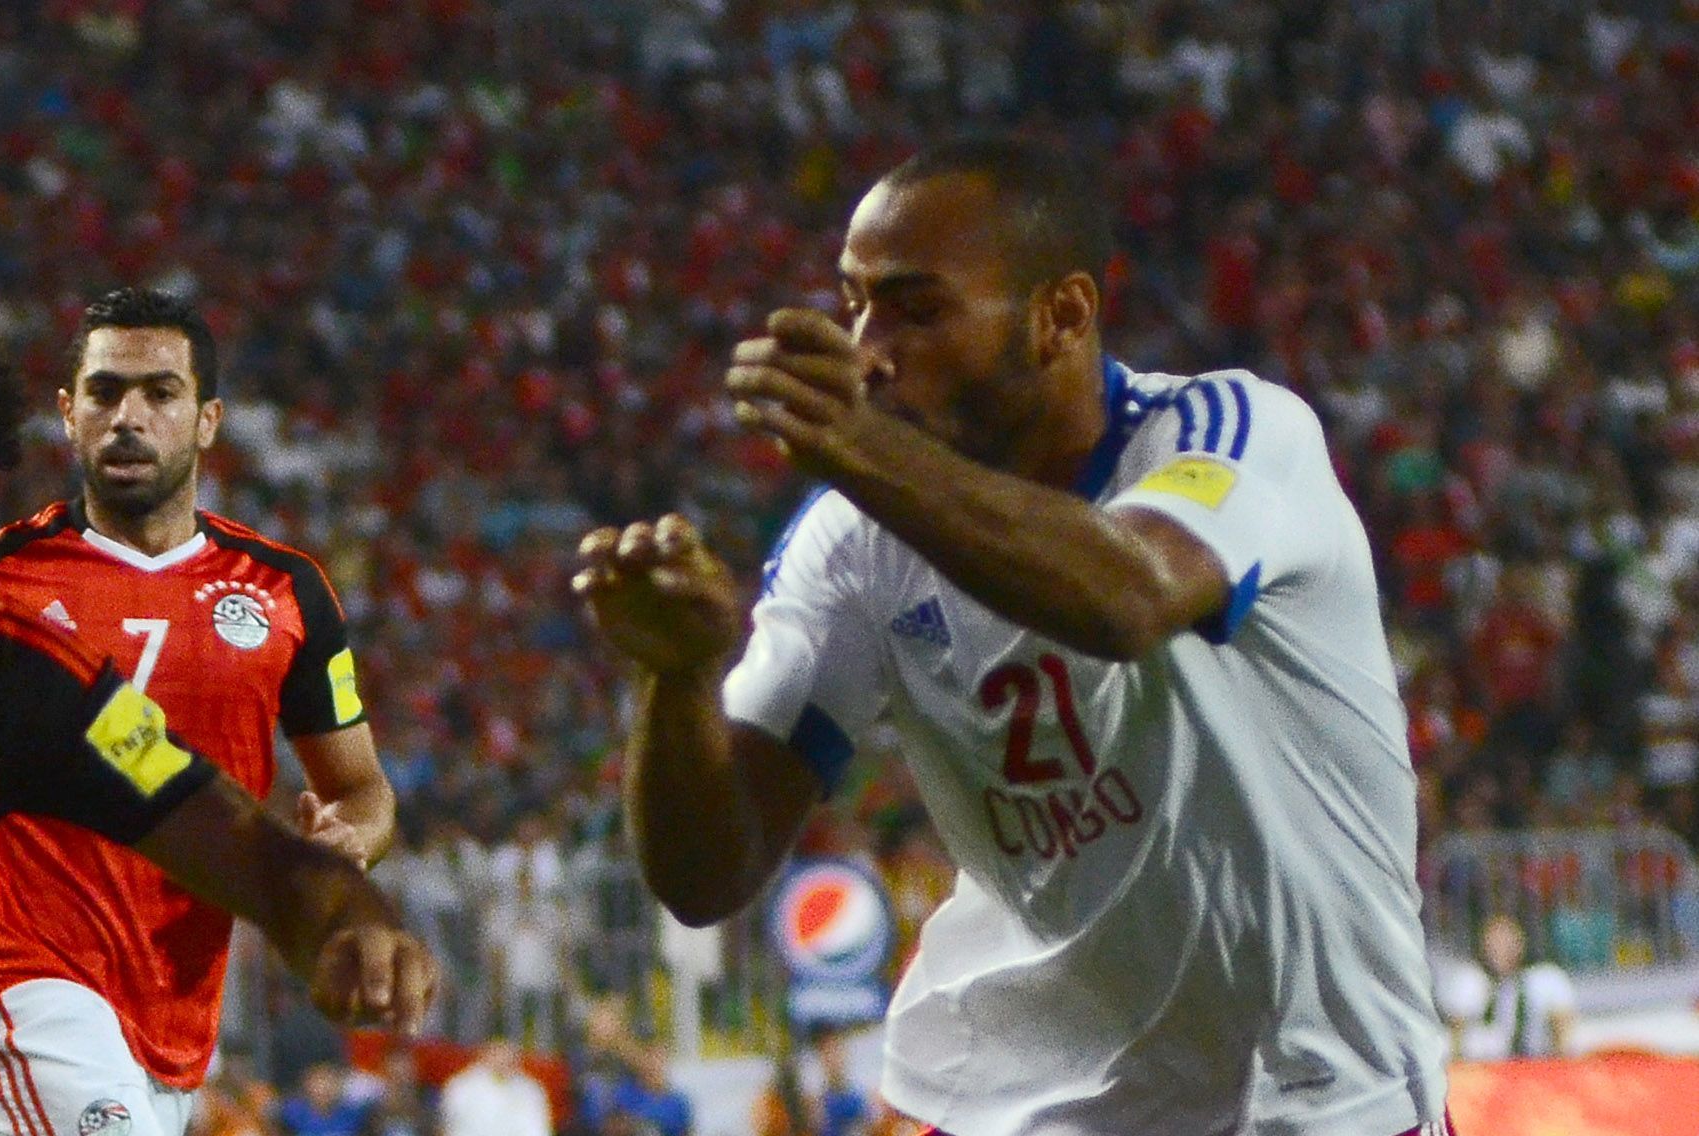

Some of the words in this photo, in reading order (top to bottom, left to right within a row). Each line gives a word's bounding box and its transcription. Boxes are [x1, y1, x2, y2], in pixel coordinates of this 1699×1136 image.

[121, 618, 170, 694] 7
[979, 654, 1096, 786] 21
[984, 770, 1143, 859] CONGO
